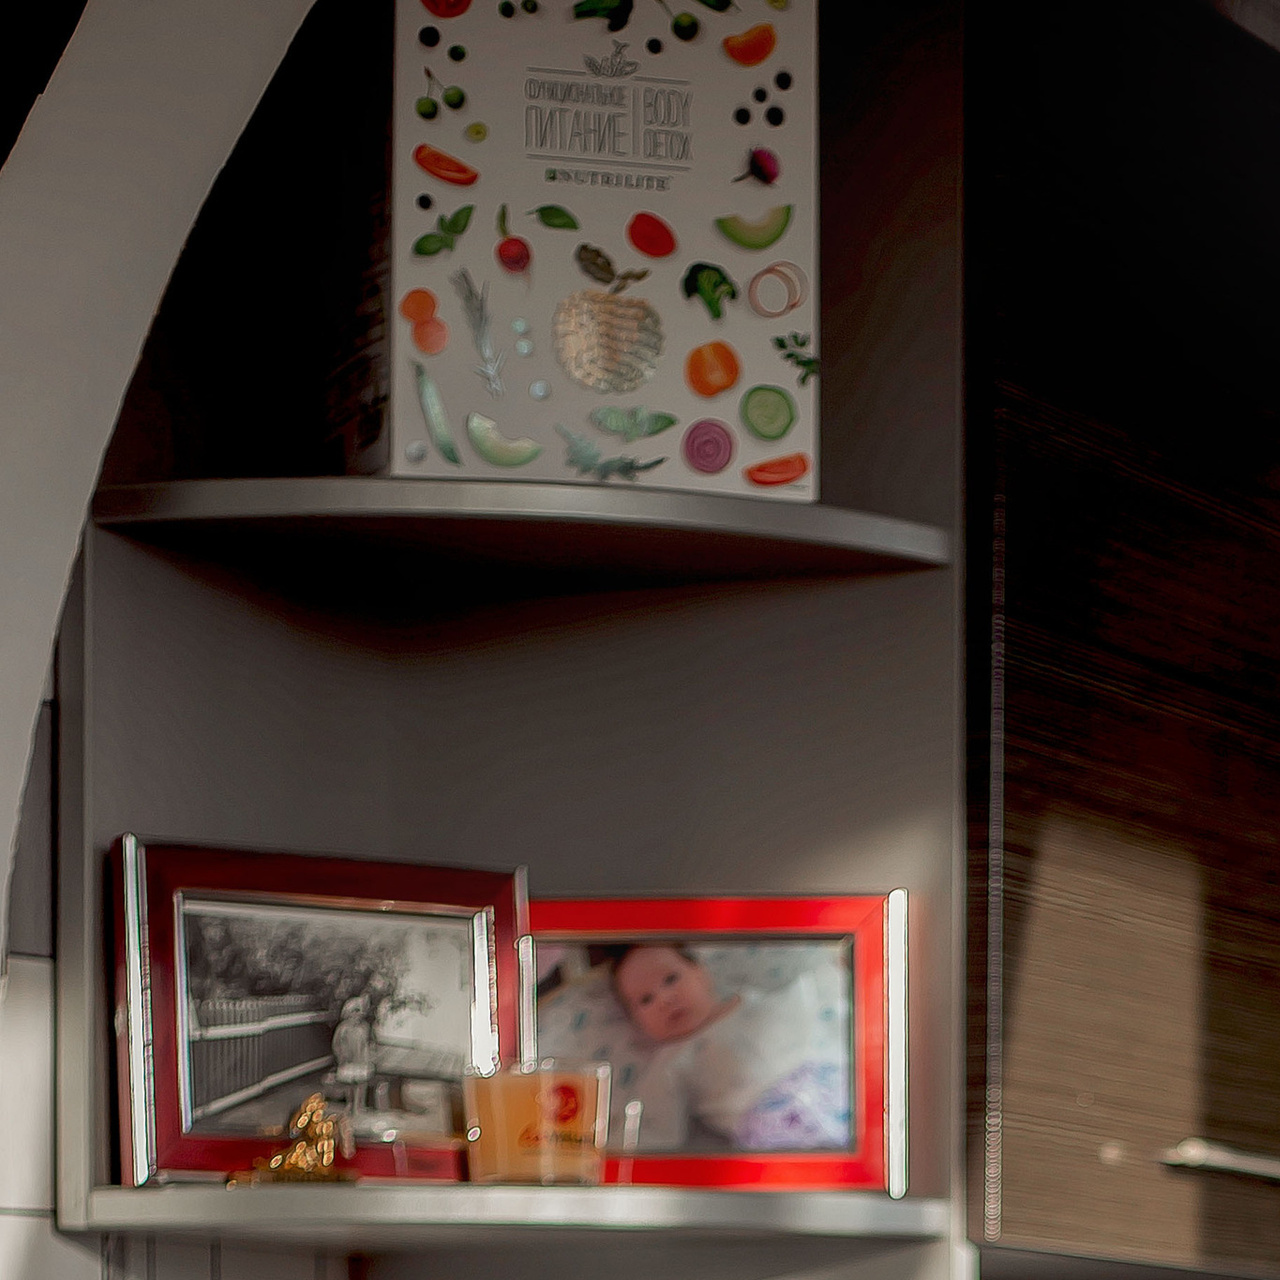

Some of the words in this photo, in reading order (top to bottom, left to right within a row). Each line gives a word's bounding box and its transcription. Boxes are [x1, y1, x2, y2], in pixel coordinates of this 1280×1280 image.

[643, 87, 693, 127] BODY
[524, 104, 628, 156] ПИТАНИЕ
[643, 128, 693, 161] DETOX
[558, 168, 668, 192] NUTRILITE
